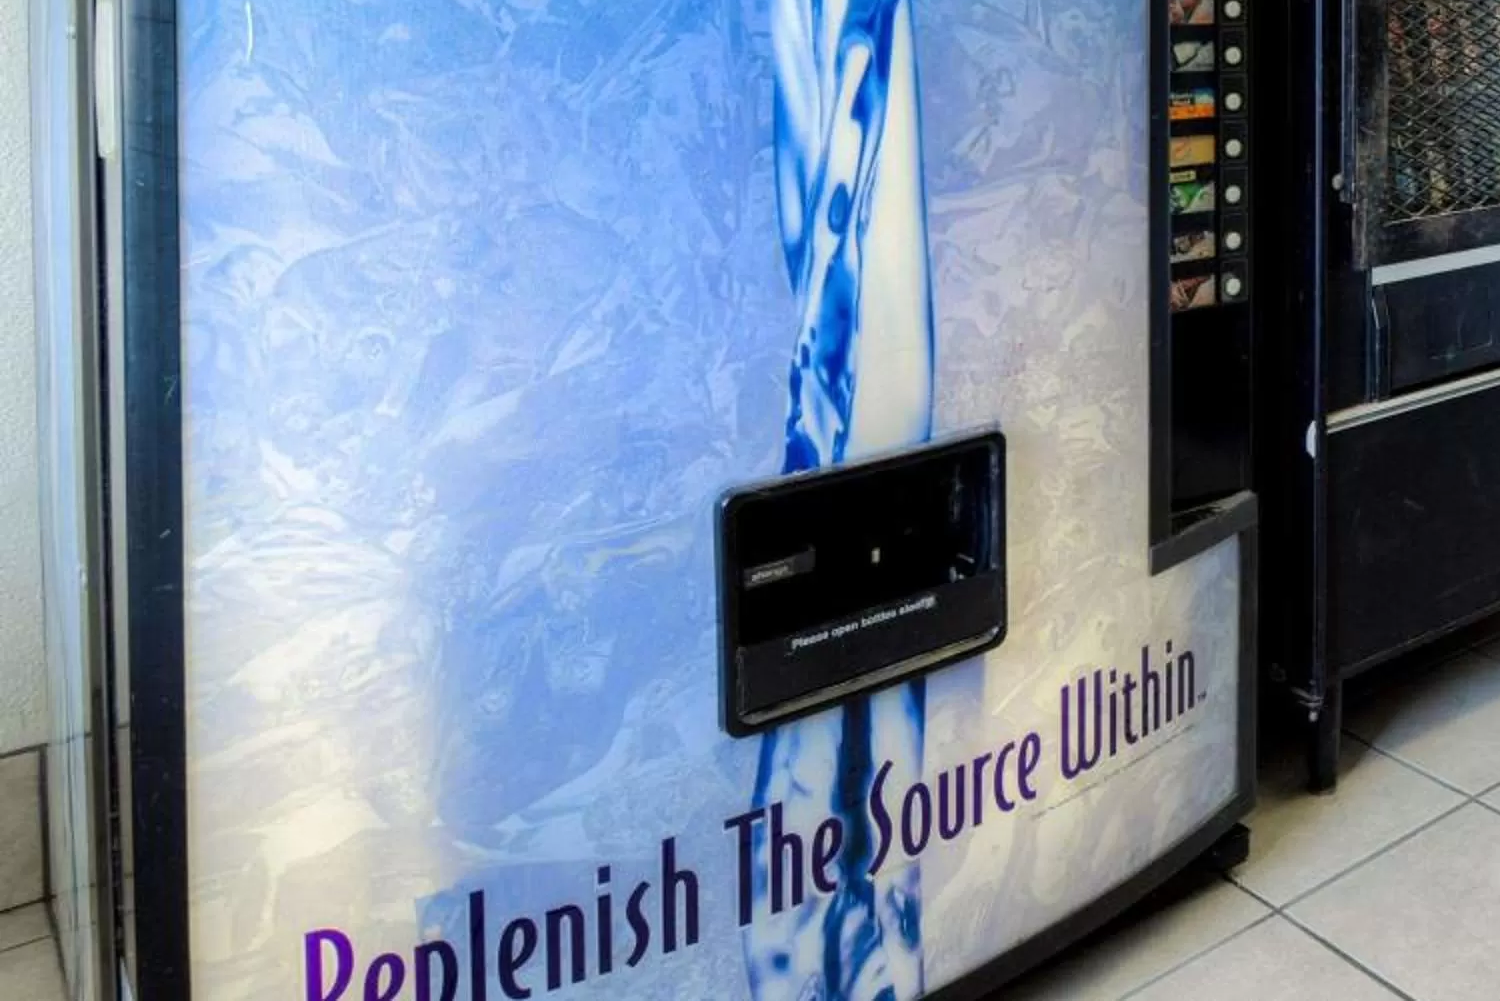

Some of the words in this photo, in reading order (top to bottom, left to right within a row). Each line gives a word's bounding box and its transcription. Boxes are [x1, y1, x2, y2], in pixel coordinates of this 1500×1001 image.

[791, 630, 829, 650] Please
[831, 621, 859, 638] open
[304, 837, 700, 1001] Replenish
[724, 801, 843, 928] The
[868, 732, 1041, 877] Source
